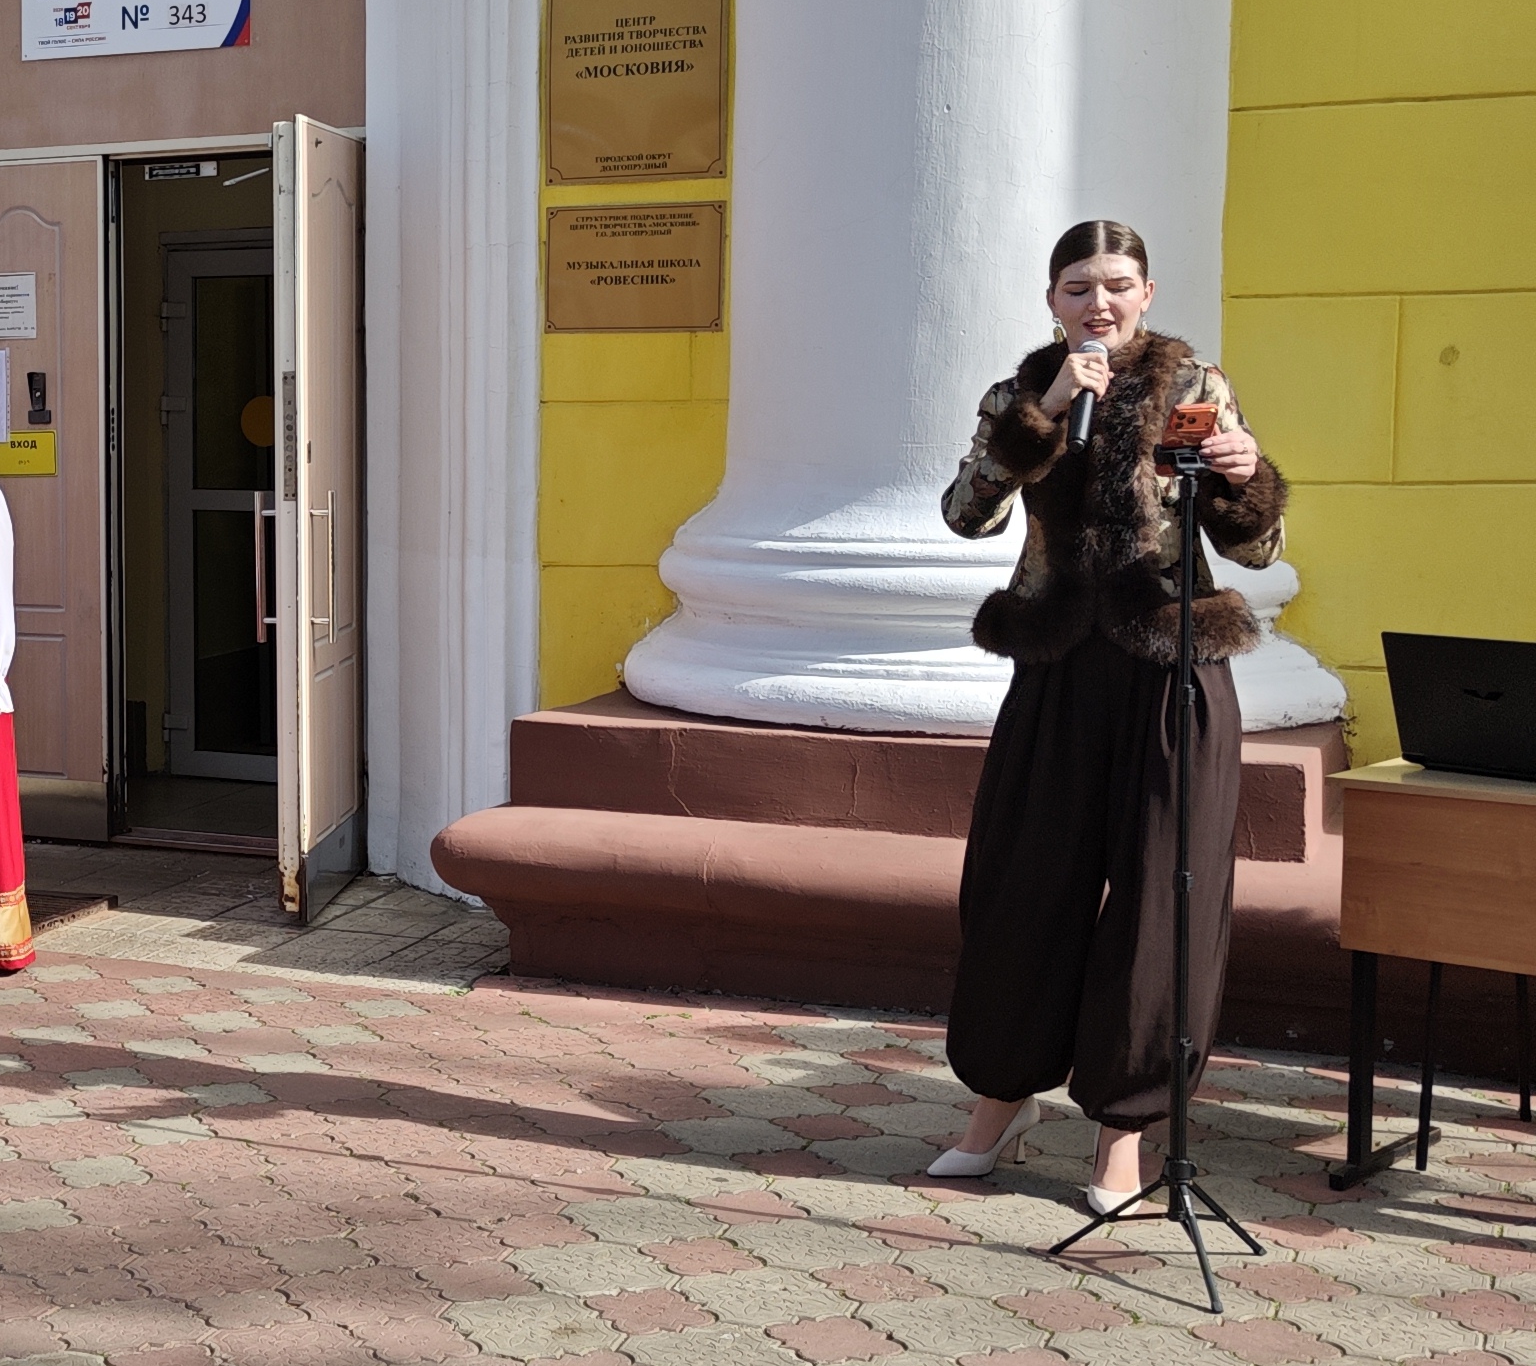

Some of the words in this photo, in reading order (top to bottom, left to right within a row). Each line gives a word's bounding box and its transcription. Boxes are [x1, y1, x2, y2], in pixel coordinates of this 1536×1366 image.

[65, 11, 76, 22] 19
[77, 5, 90, 16] 20
[54, 17, 65, 27] 18
[121, 3, 150, 31] №
[168, 3, 207, 26] 343
[615, 15, 656, 30] ЦЕНТР
[564, 31, 625, 45] РАЗВИТИЯ
[627, 25, 707, 40] ТВОРЧЕСТВА
[565, 42, 606, 59] ДЕТЕЙ
[608, 43, 618, 55] И
[620, 38, 704, 54] ЮНОШЕСТВА
[575, 59, 695, 80] «МОСКОВИЯ»
[595, 152, 644, 164] ГОРОДСКОЙ
[645, 151, 673, 162] ОКРУГ
[599, 161, 668, 173] ДОЛГОПРУДНЫЙ
[575, 214, 629, 223] СТРУКТУРНОЕ
[630, 212, 694, 221] ПОДРАЗДЕЛЕНИЕ
[569, 223, 598, 232] ЦЕНТРА
[599, 221, 648, 230] ТВОРЧЕСТВА
[648, 220, 700, 229] «МОСКОВИЯ»
[609, 228, 672, 238] ДОЛГОПРУДНЫЙ
[566, 260, 655, 271] МУЗЫКАЛЬНАЯ
[657, 258, 701, 269] ШКОЛА
[590, 274, 676, 287] «РОВЕСНИК»
[10, 439, 38, 450] ВХОД
